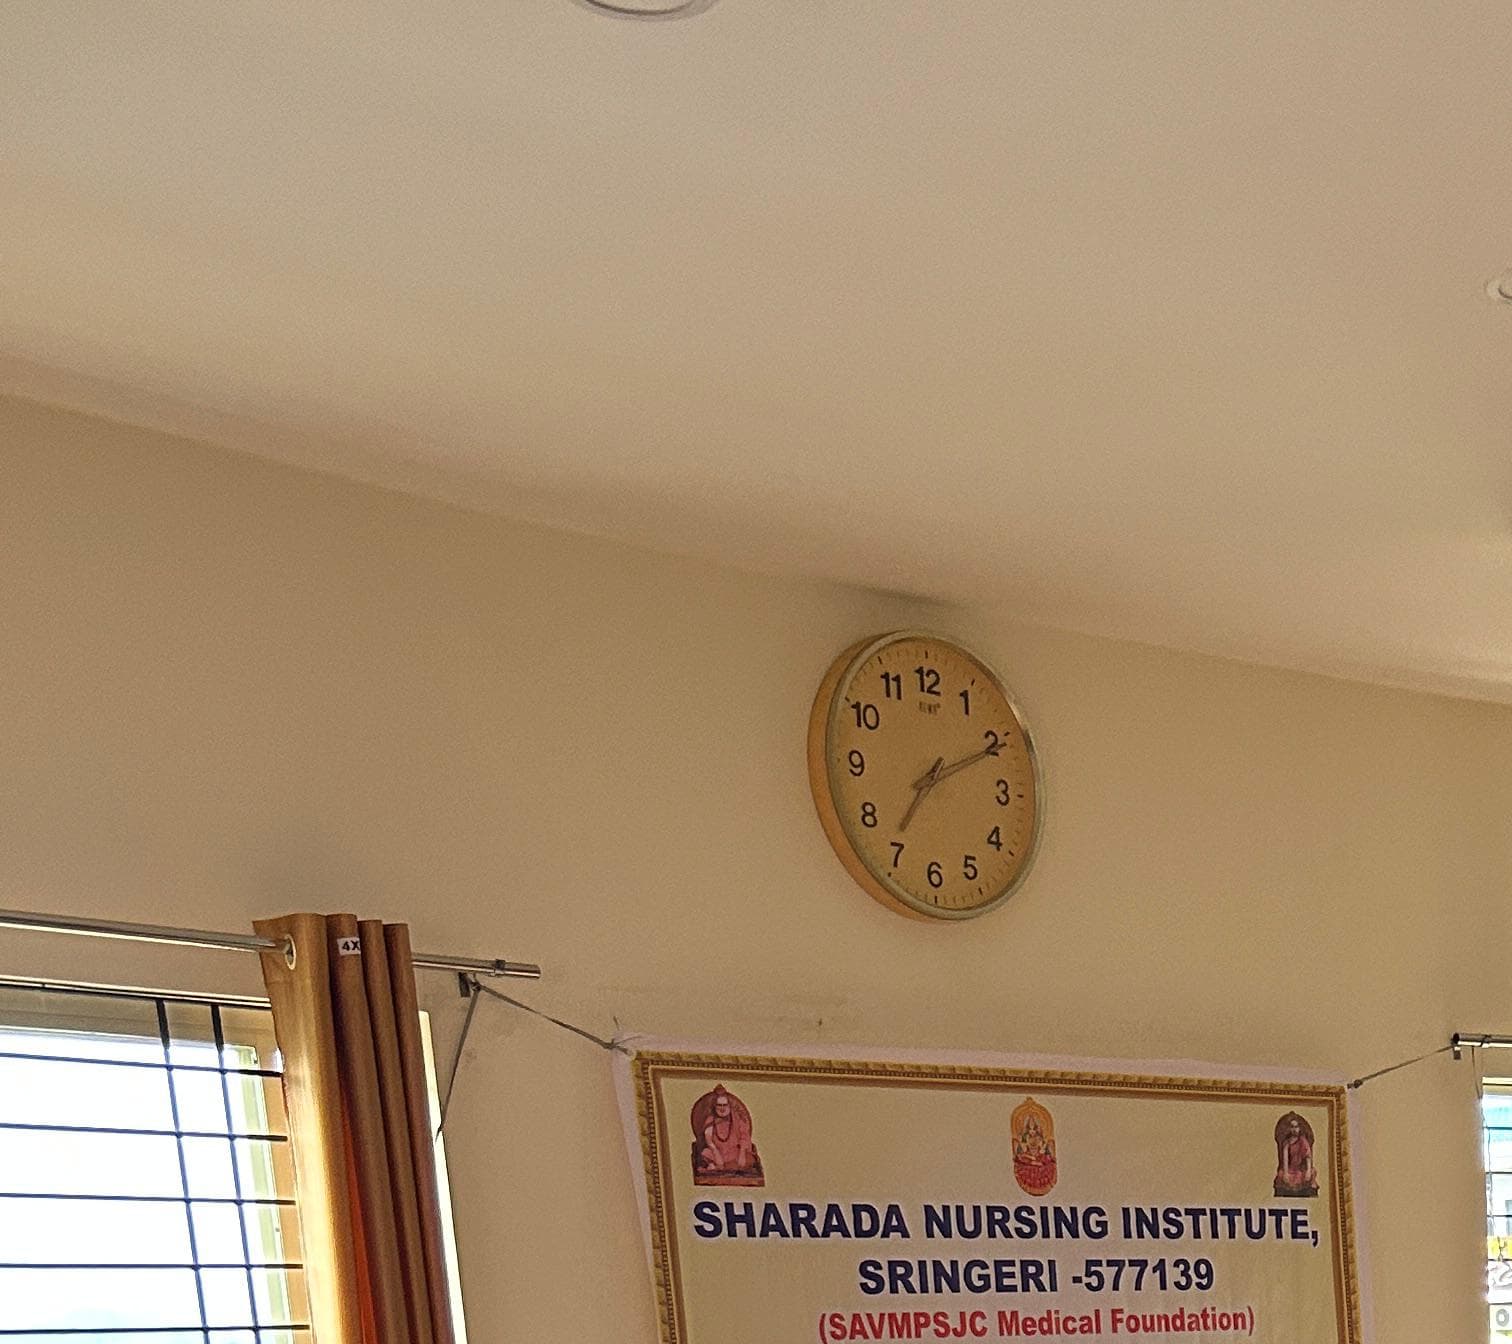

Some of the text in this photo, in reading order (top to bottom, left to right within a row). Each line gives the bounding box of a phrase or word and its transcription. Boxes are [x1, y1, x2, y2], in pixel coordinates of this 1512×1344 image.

[880, 671, 902, 700] 11
[915, 666, 941, 696] 12
[851, 701, 880, 730] 10
[960, 690, 970, 716] 1
[984, 730, 999, 756] 2
[849, 750, 865, 777] 9
[996, 779, 1010, 806] 3
[861, 802, 878, 828] 8
[987, 826, 1002, 851] 4
[890, 842, 905, 868] 7
[963, 855, 978, 880] 5
[927, 862, 943, 888] 6
[693, 1201, 1318, 1248] SHARADA NURSING INSTITUTE,
[859, 1258, 1214, 1295] SRINGERI -577139
[998, 1308, 1102, 1337] Medical
[1110, 1305, 1255, 1336] Foundation)
